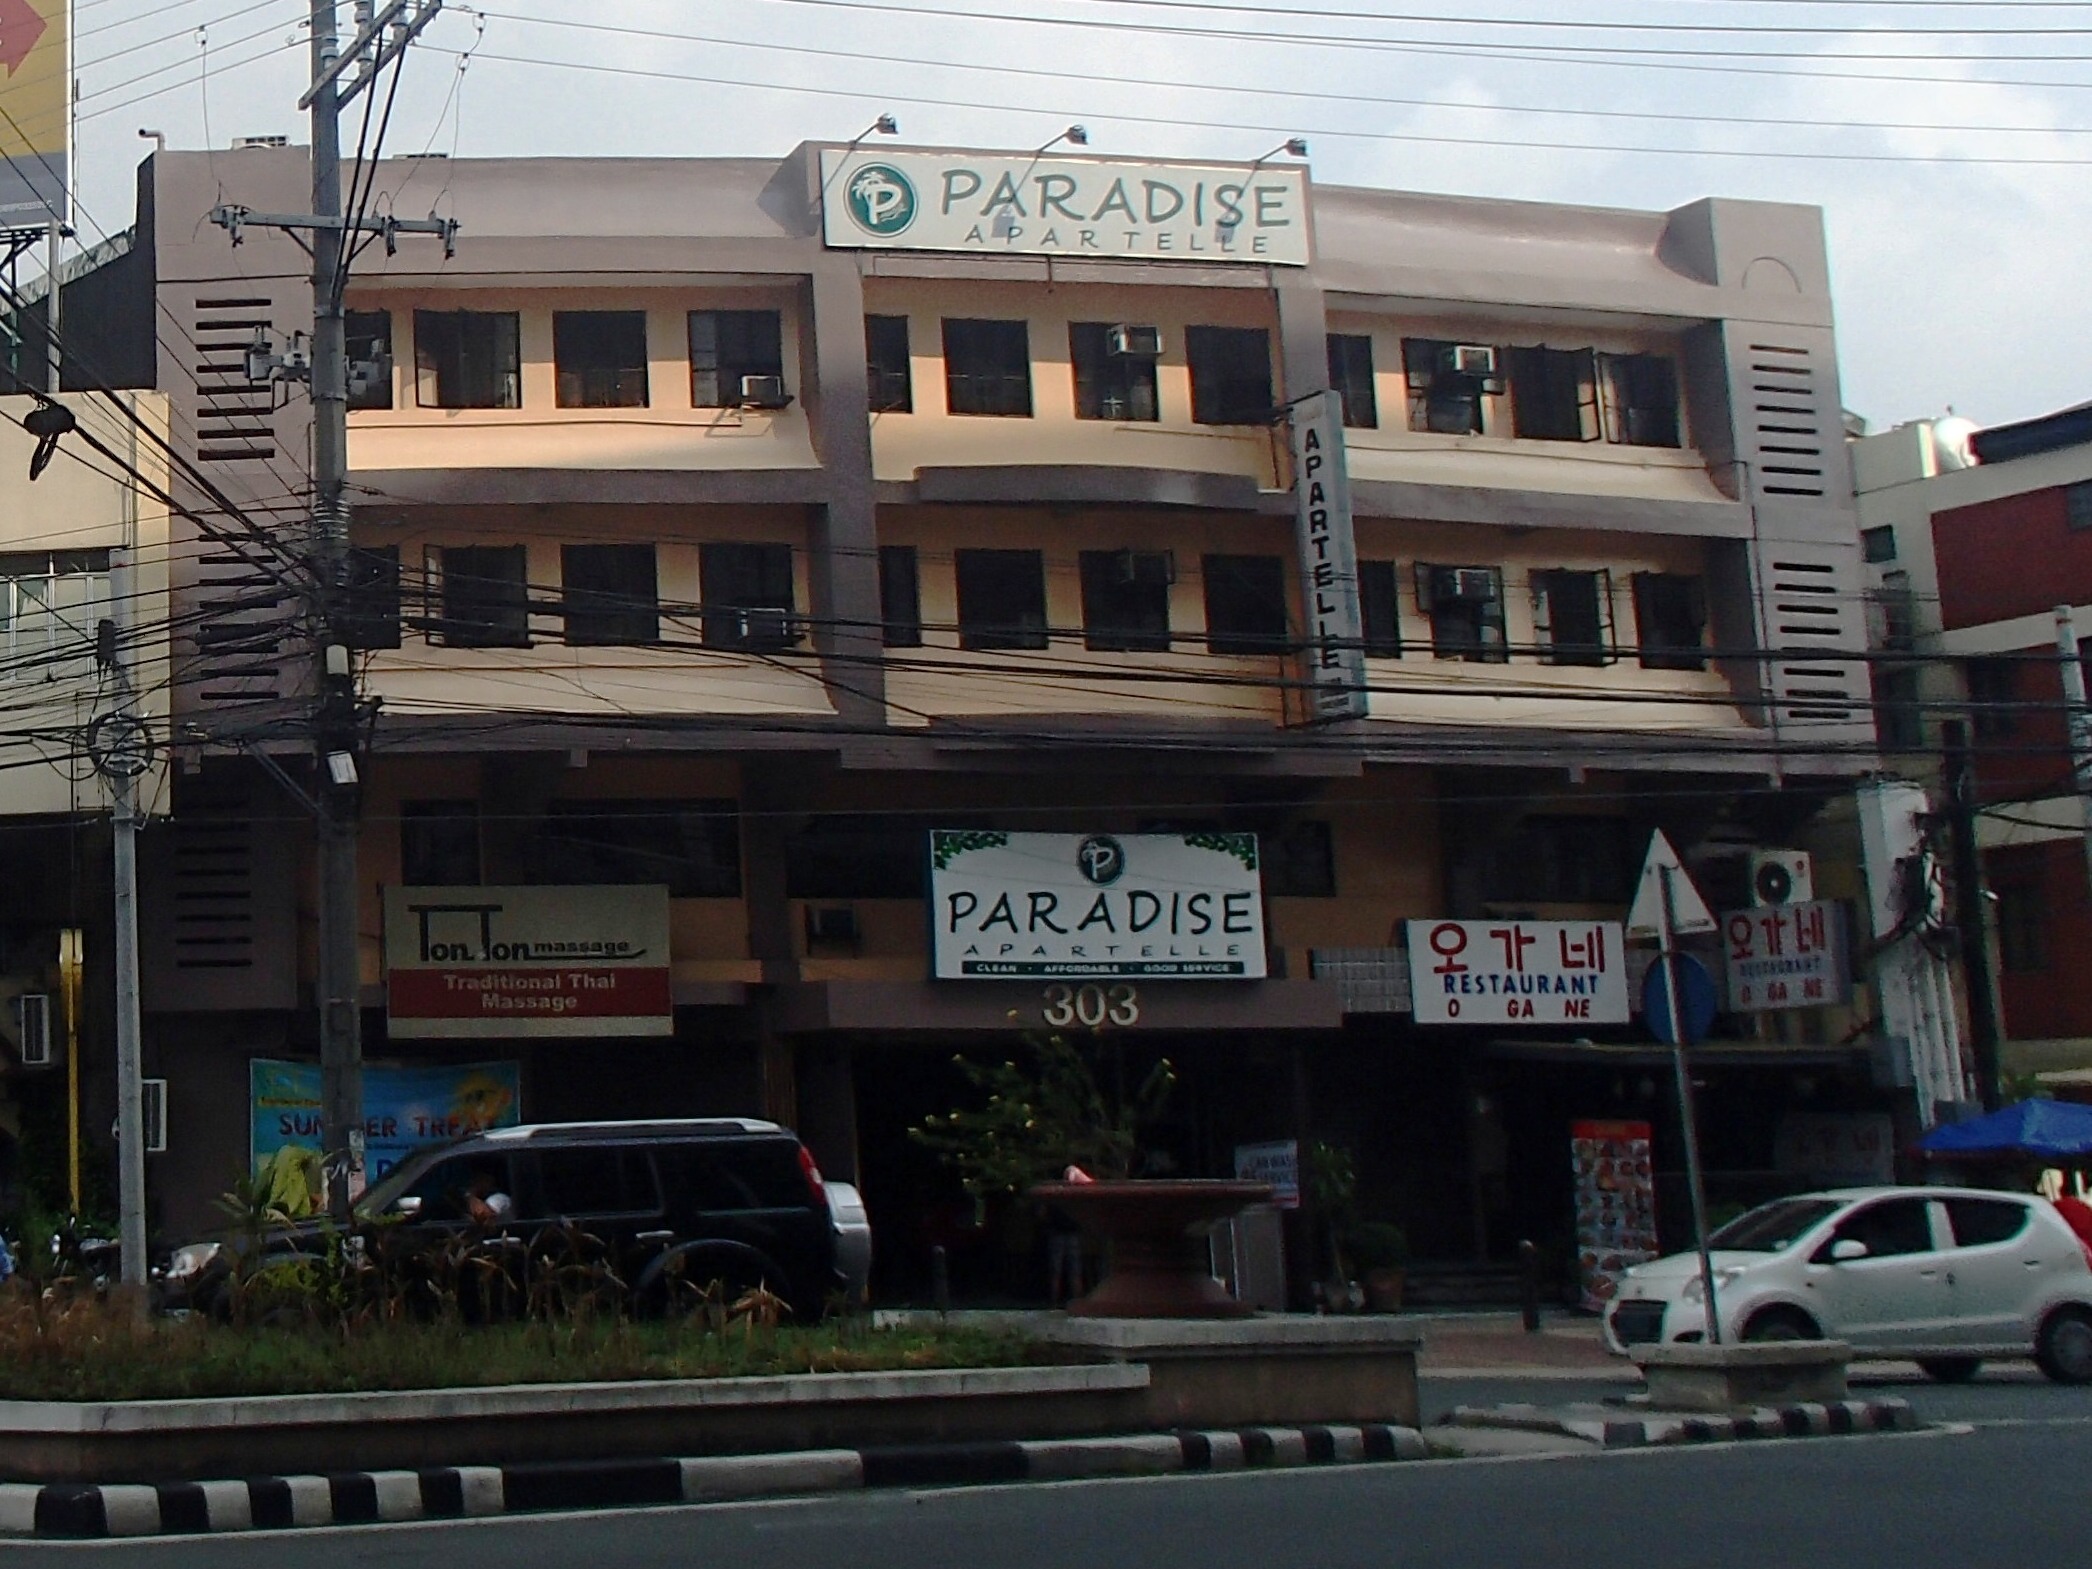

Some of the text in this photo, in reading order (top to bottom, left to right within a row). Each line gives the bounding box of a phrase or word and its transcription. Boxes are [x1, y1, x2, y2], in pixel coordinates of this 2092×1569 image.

[942, 168, 1291, 228] PARADISE
[963, 224, 1269, 254] APARTELLE
[1304, 427, 1341, 670] APARTELLE
[947, 889, 1255, 935] PARADISE
[534, 939, 631, 955] massage
[962, 943, 1240, 957] APARTELLE
[976, 963, 1017, 973] CLEAN
[1044, 963, 1120, 974] AFFORDABLE
[444, 972, 616, 991] Traditional Thai
[1444, 973, 1598, 995] RESTAURANT
[481, 994, 578, 1011] Massage
